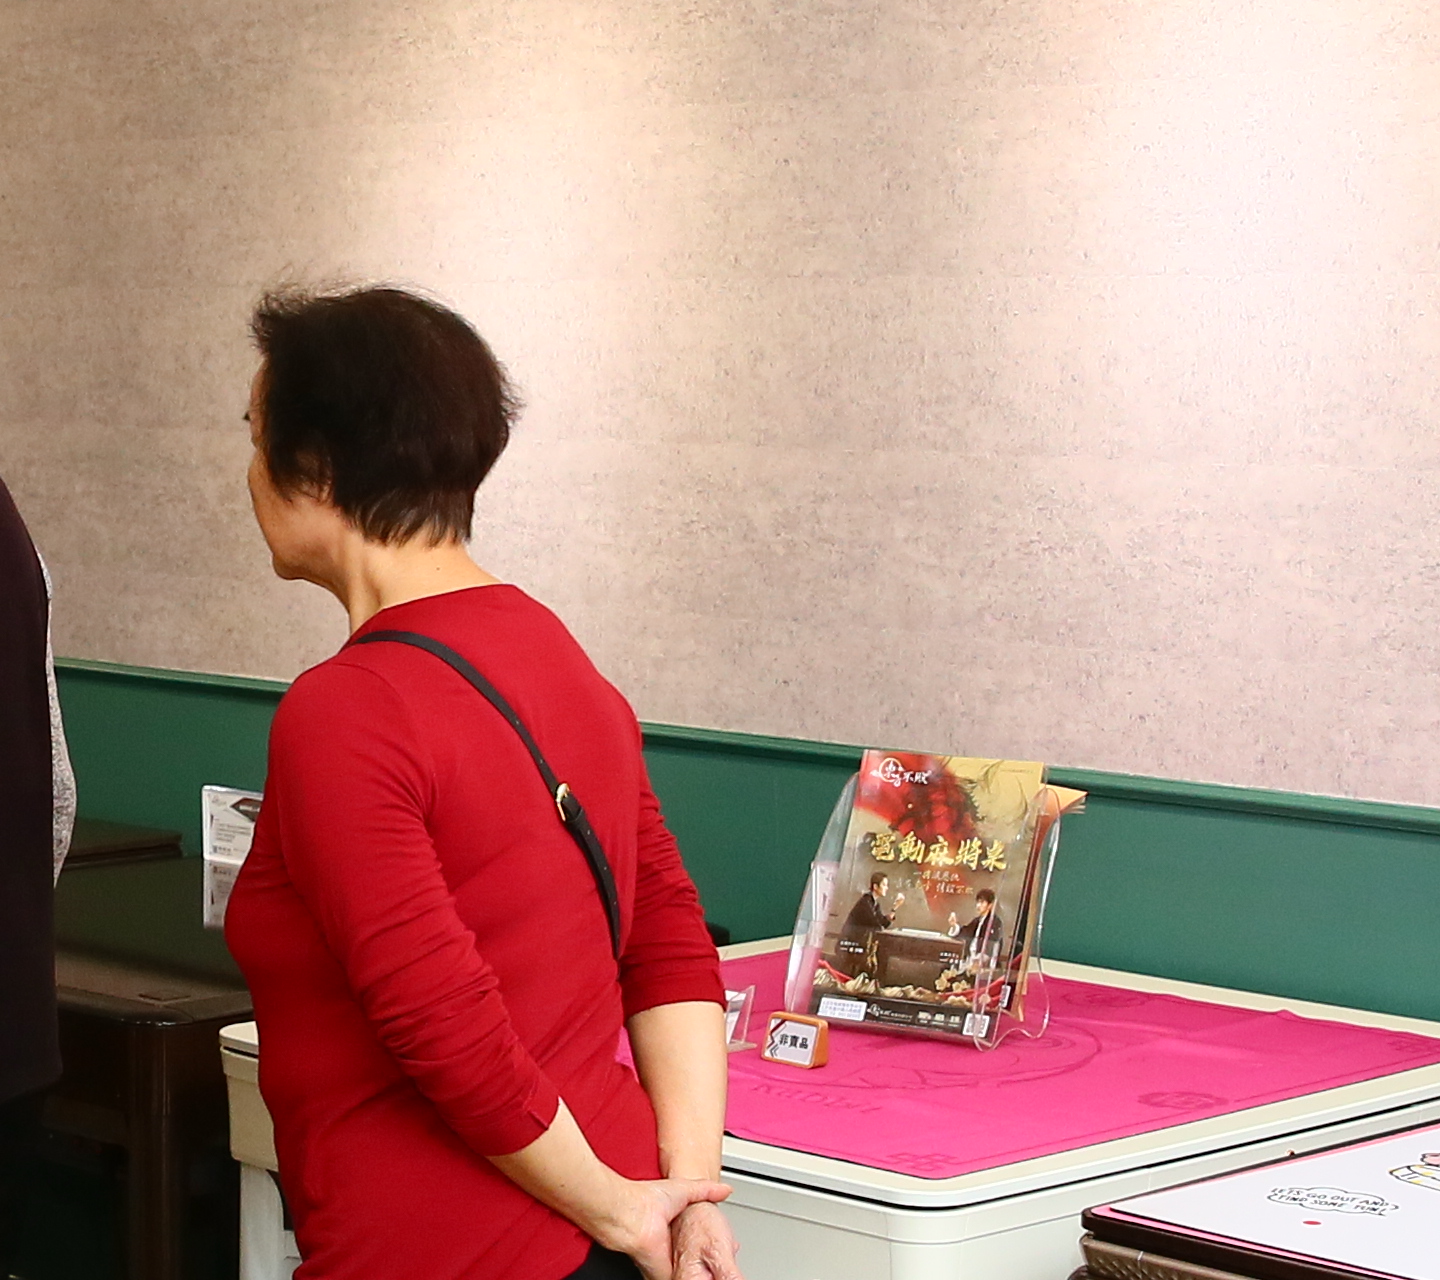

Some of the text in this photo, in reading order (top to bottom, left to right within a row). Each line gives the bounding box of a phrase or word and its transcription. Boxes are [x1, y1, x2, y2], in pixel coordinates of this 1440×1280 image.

[870, 831, 1007, 872] 電動麻將桌
[779, 1033, 810, 1050] 非賣品
